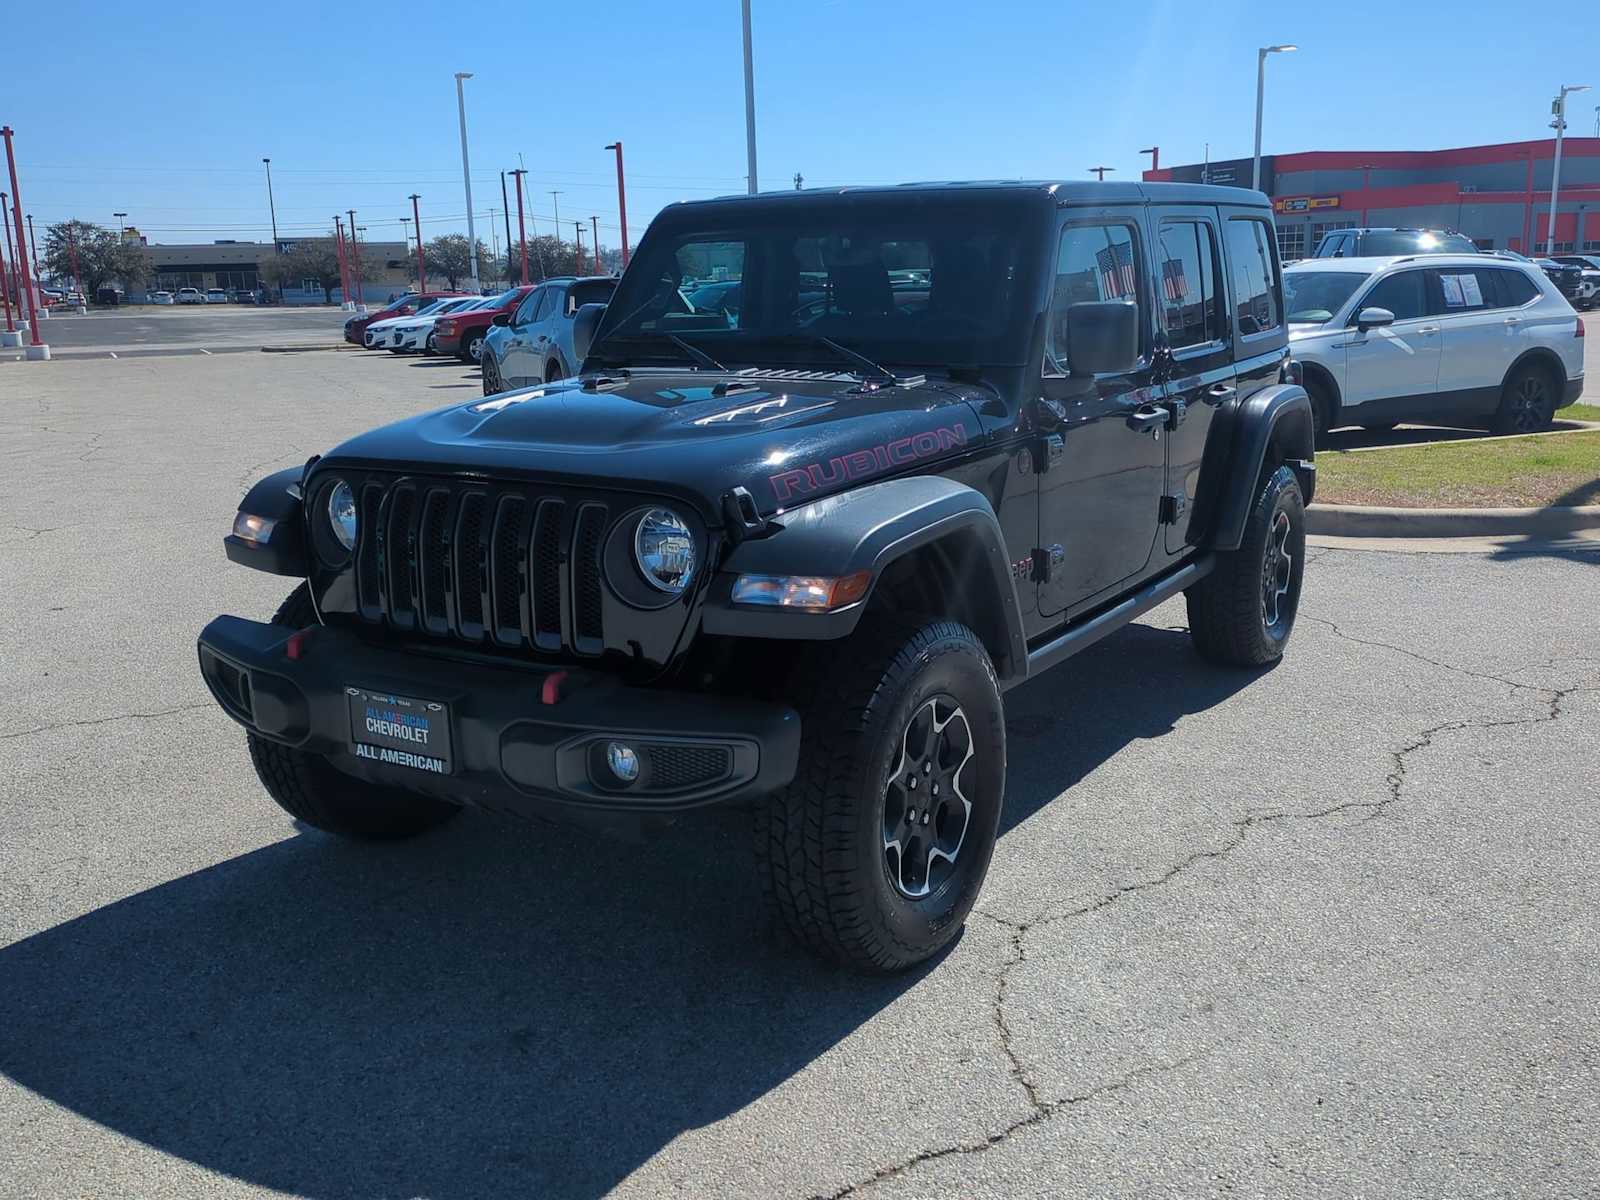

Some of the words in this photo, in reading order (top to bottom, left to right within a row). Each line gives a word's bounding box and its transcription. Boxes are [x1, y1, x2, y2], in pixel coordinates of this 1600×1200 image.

[769, 423, 968, 500] RUBICON
[366, 717, 429, 744] CHEVROLET
[356, 743, 379, 760] ALL
[380, 749, 443, 773] AMERICAN
